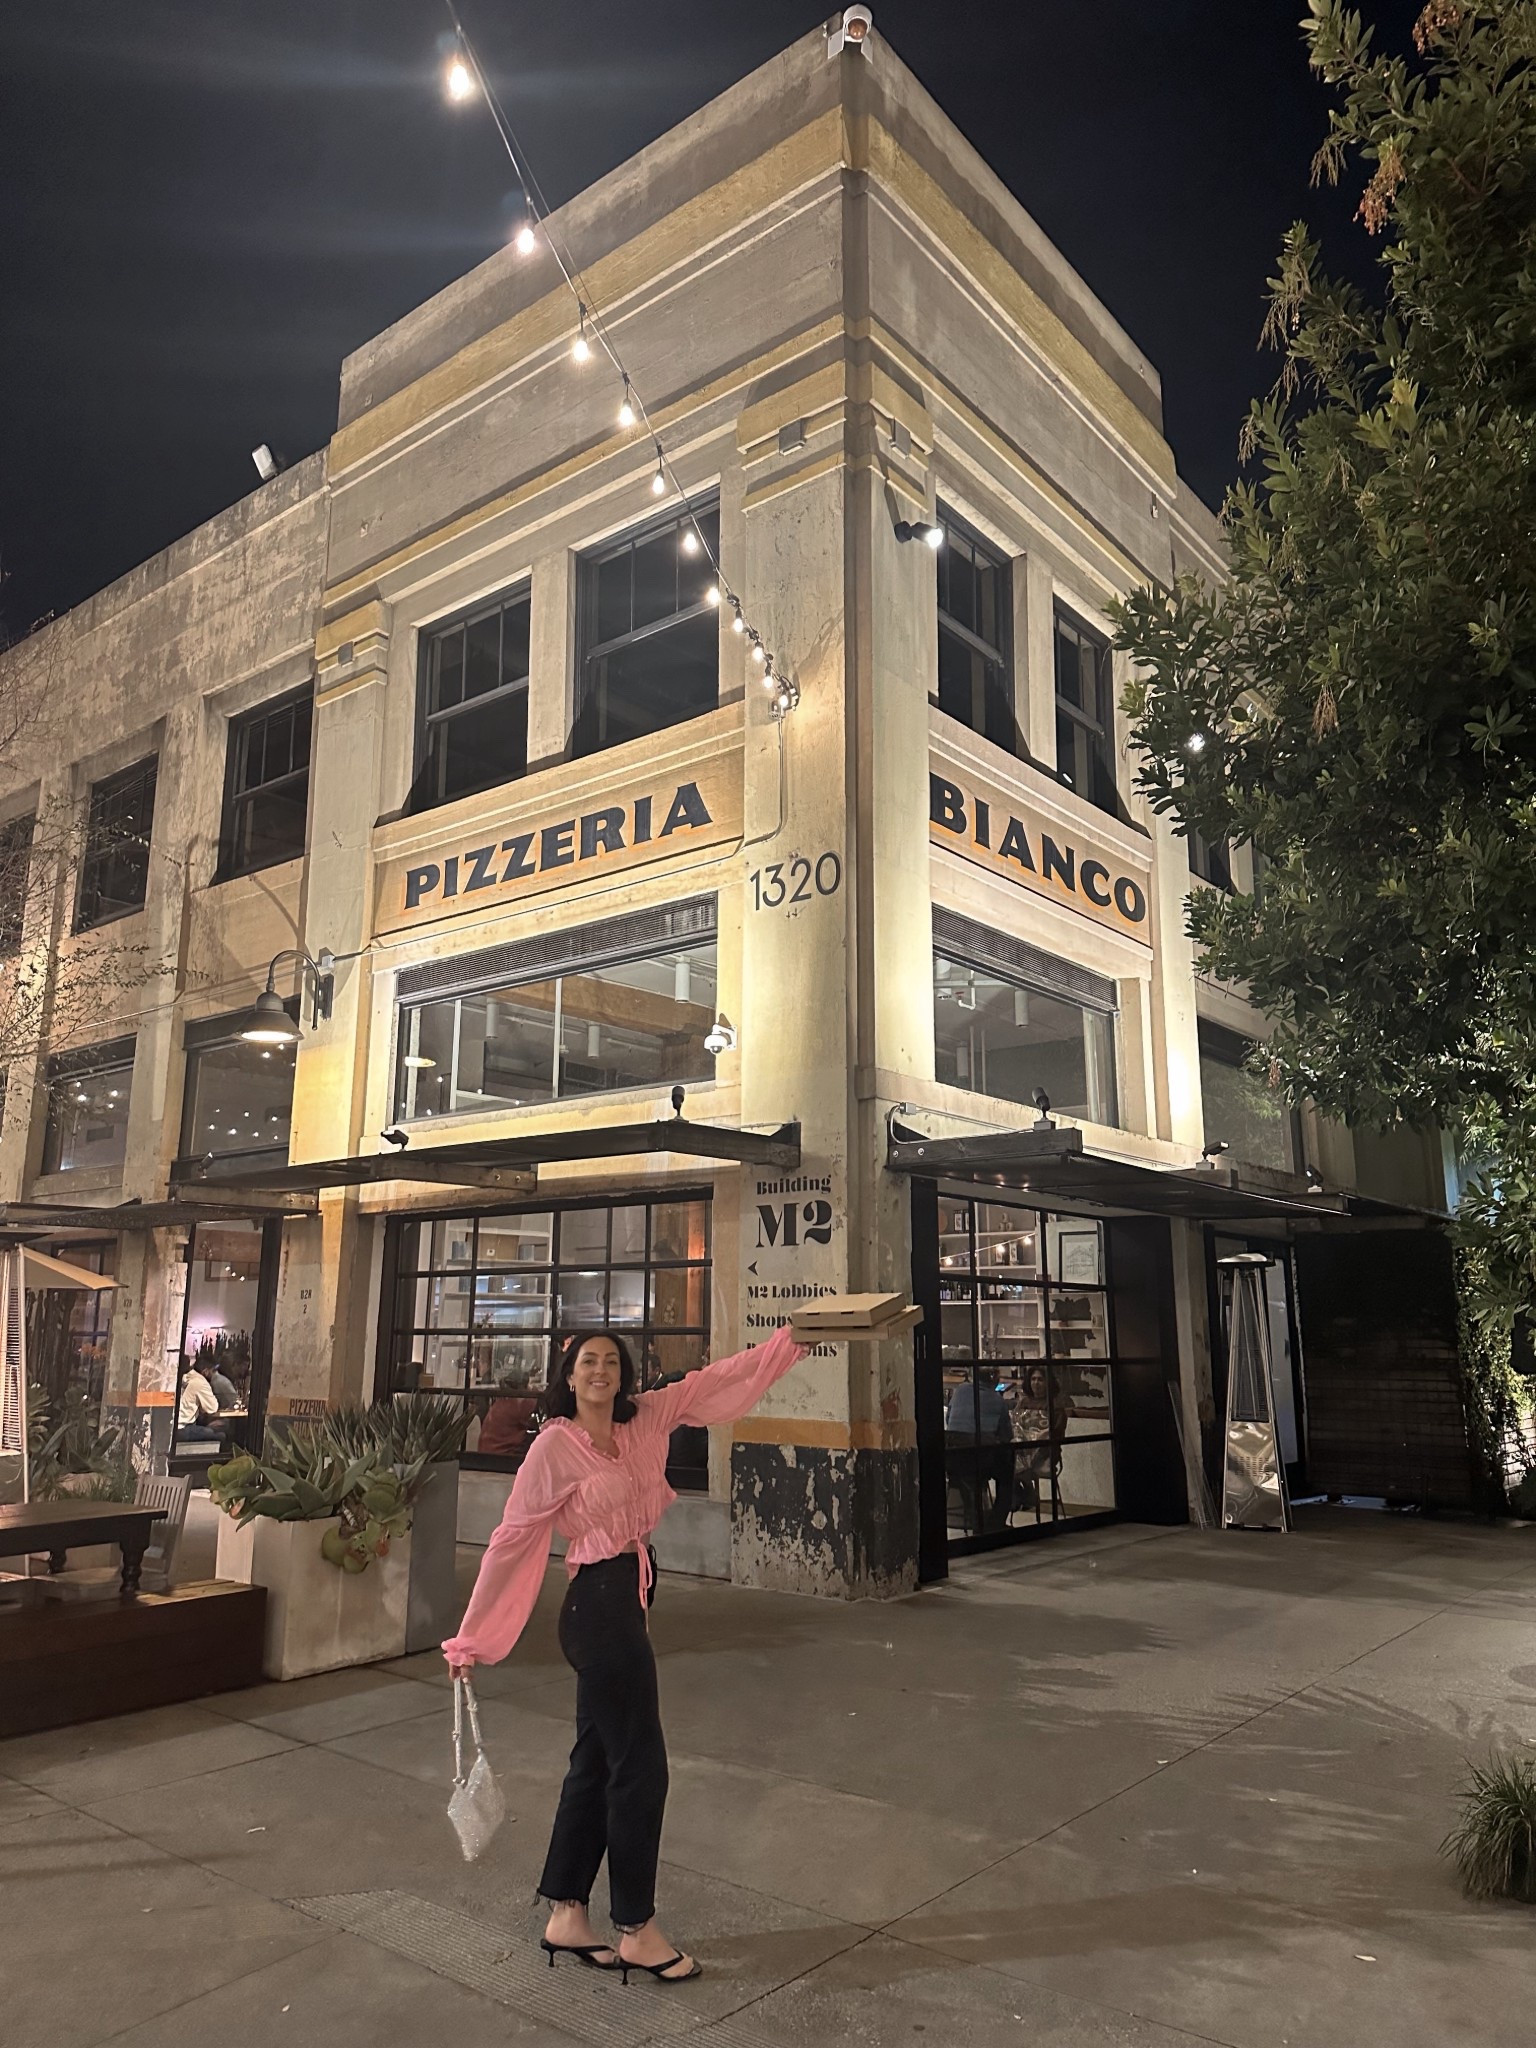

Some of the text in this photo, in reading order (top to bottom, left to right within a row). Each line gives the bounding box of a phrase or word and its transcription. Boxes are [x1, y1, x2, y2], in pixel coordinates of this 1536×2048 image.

[404, 782, 713, 910] PIZZERIA
[929, 772, 1146, 922] BIANCO
[750, 852, 841, 912] 1320
[756, 1174, 832, 1195] Building
[755, 1199, 833, 1248] M2
[747, 1283, 838, 1298] M2 Lobbies
